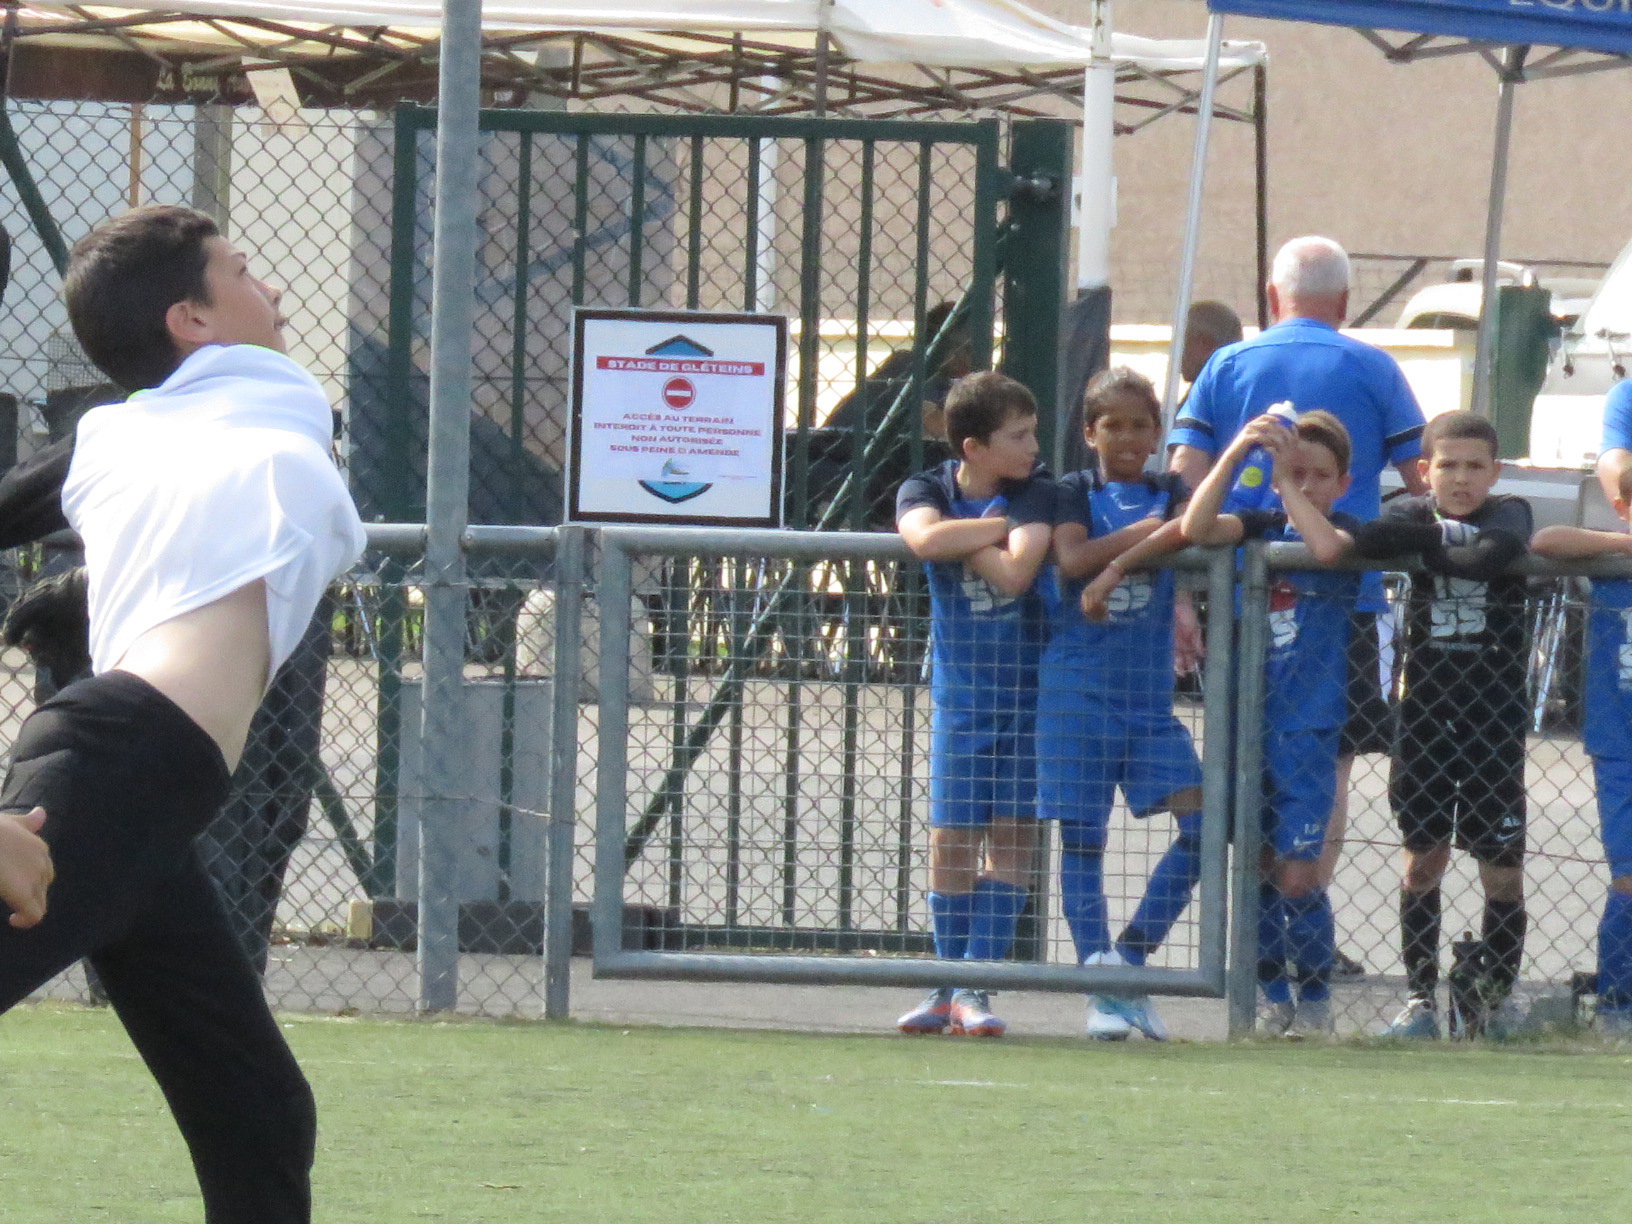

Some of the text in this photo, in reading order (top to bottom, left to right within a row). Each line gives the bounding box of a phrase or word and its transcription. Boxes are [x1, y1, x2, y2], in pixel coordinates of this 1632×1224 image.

[607, 359, 754, 374] STADE DE GLÉTEINS
[664, 414, 680, 422] AU
[682, 416, 735, 425] TERRAIN
[594, 422, 647, 432] INTERDIT
[660, 425, 696, 434] TOUTE
[698, 427, 762, 437] PERSONNE
[631, 435, 657, 443] NON
[610, 444, 639, 453] SOUS
[641, 446, 676, 455] PEINE
